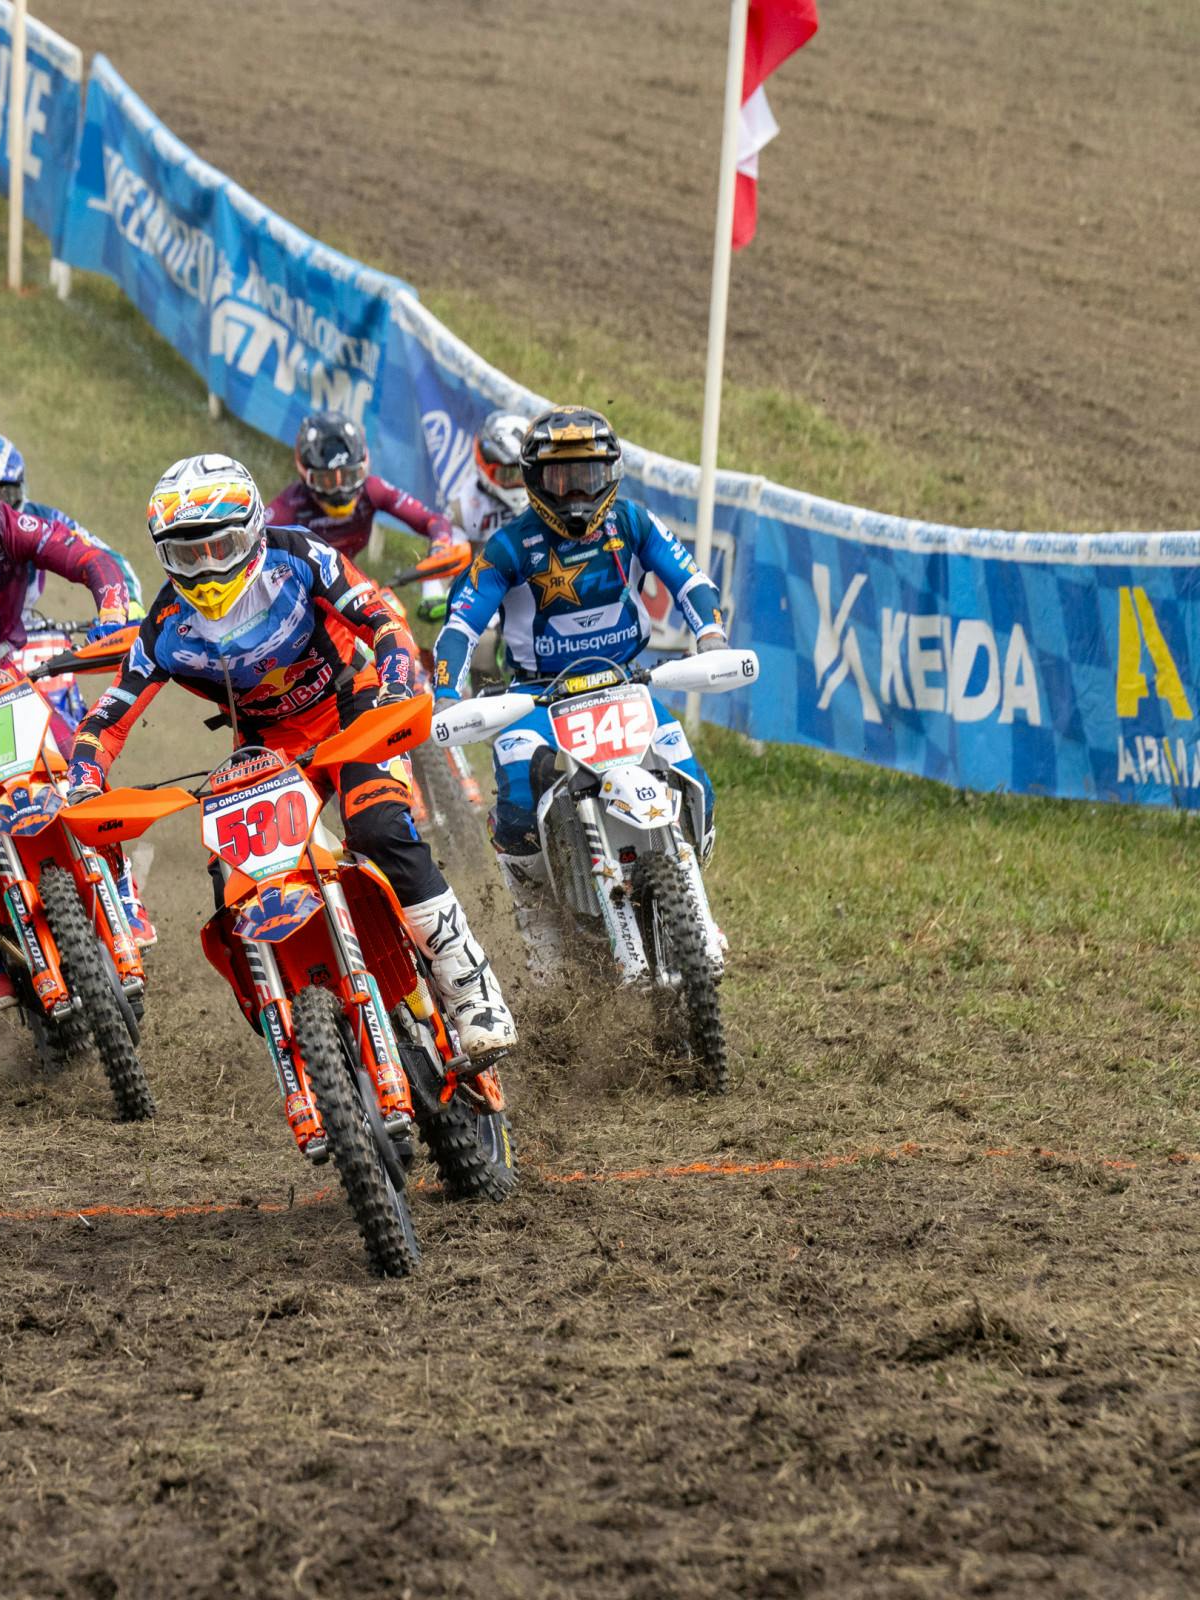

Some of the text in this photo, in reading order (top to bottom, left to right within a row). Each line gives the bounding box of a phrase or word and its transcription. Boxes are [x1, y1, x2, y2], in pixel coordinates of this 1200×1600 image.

[557, 624, 639, 655] Husqvarna
[291, 662, 333, 706] Bull
[387, 727, 412, 746] KTM
[566, 701, 650, 759] 342
[215, 757, 281, 785] RENTHAL
[98, 819, 124, 833] KTM
[215, 790, 310, 867] 530
